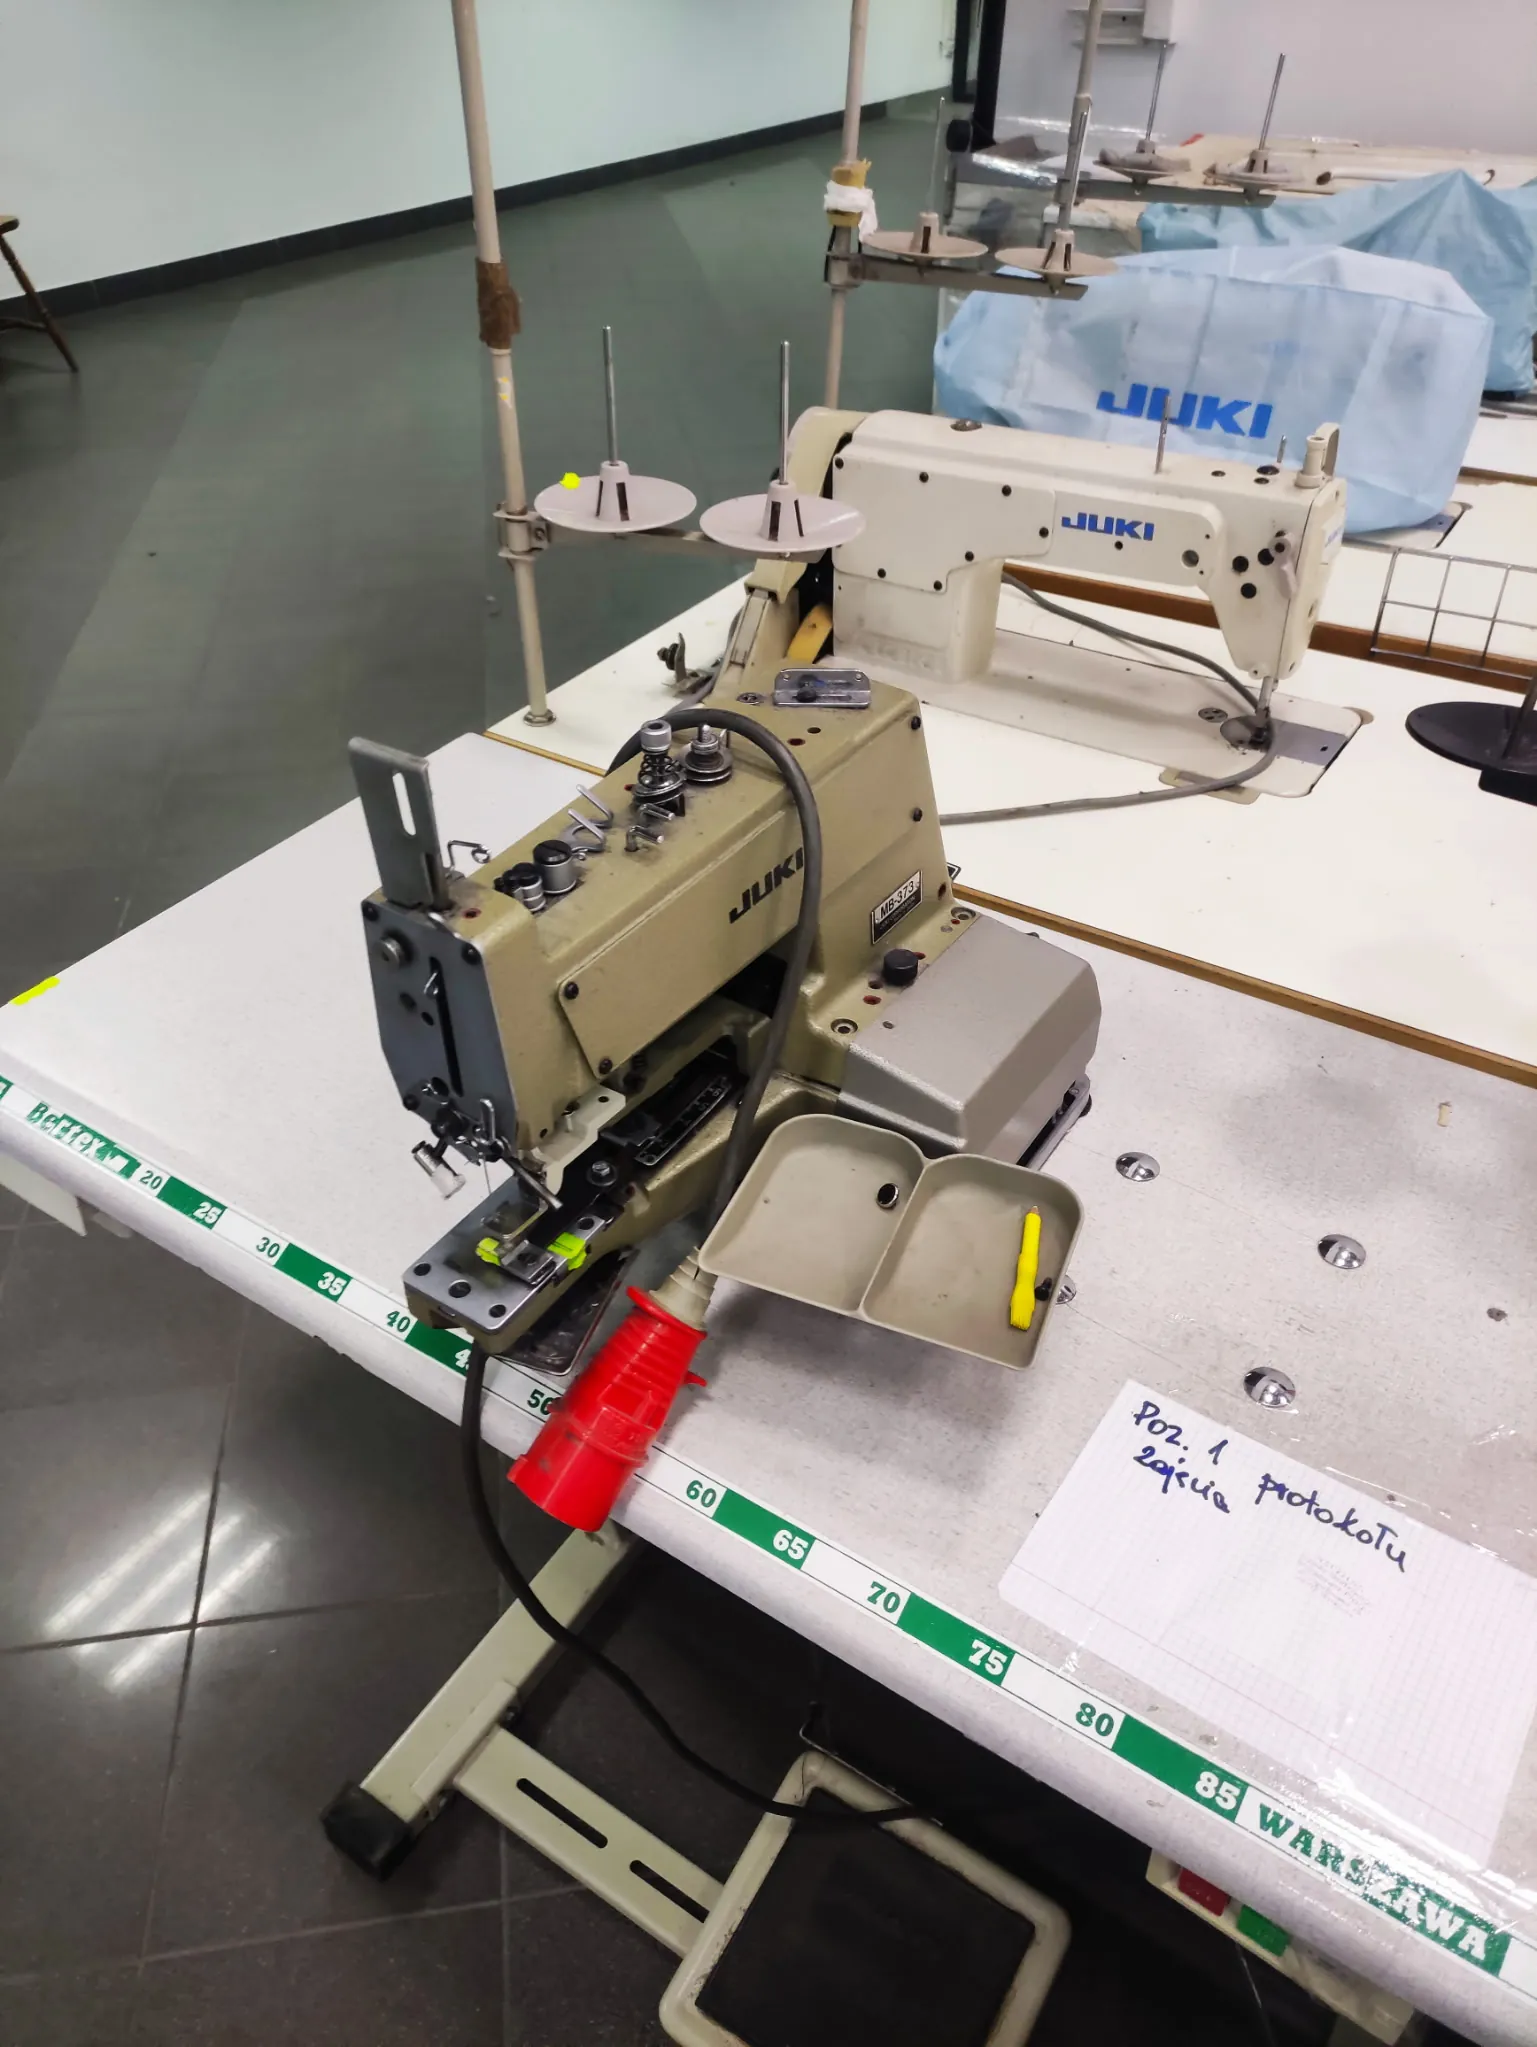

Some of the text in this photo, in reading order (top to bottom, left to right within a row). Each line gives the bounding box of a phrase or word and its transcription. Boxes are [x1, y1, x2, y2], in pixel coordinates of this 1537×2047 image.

[1096, 383, 1273, 439] JUKI
[1061, 512, 1155, 542] JUKI
[729, 847, 804, 924] JUKI
[880, 880, 914, 919] MB-373
[1208, 1439, 1229, 1466] 1
[140, 1170, 163, 1190] 20
[193, 1201, 221, 1227] 25
[255, 1237, 280, 1259] 30
[317, 1271, 345, 1297] 35
[386, 1308, 411, 1333] 40
[455, 1348, 472, 1370] 4
[685, 1479, 716, 1508] 60
[772, 1529, 808, 1560] 65
[867, 1581, 900, 1613] 70
[968, 1640, 1008, 1676] 75
[1075, 1702, 1115, 1738] 80
[1195, 1771, 1241, 1811] 85
[1259, 1802, 1489, 1961] WARSZAWA
